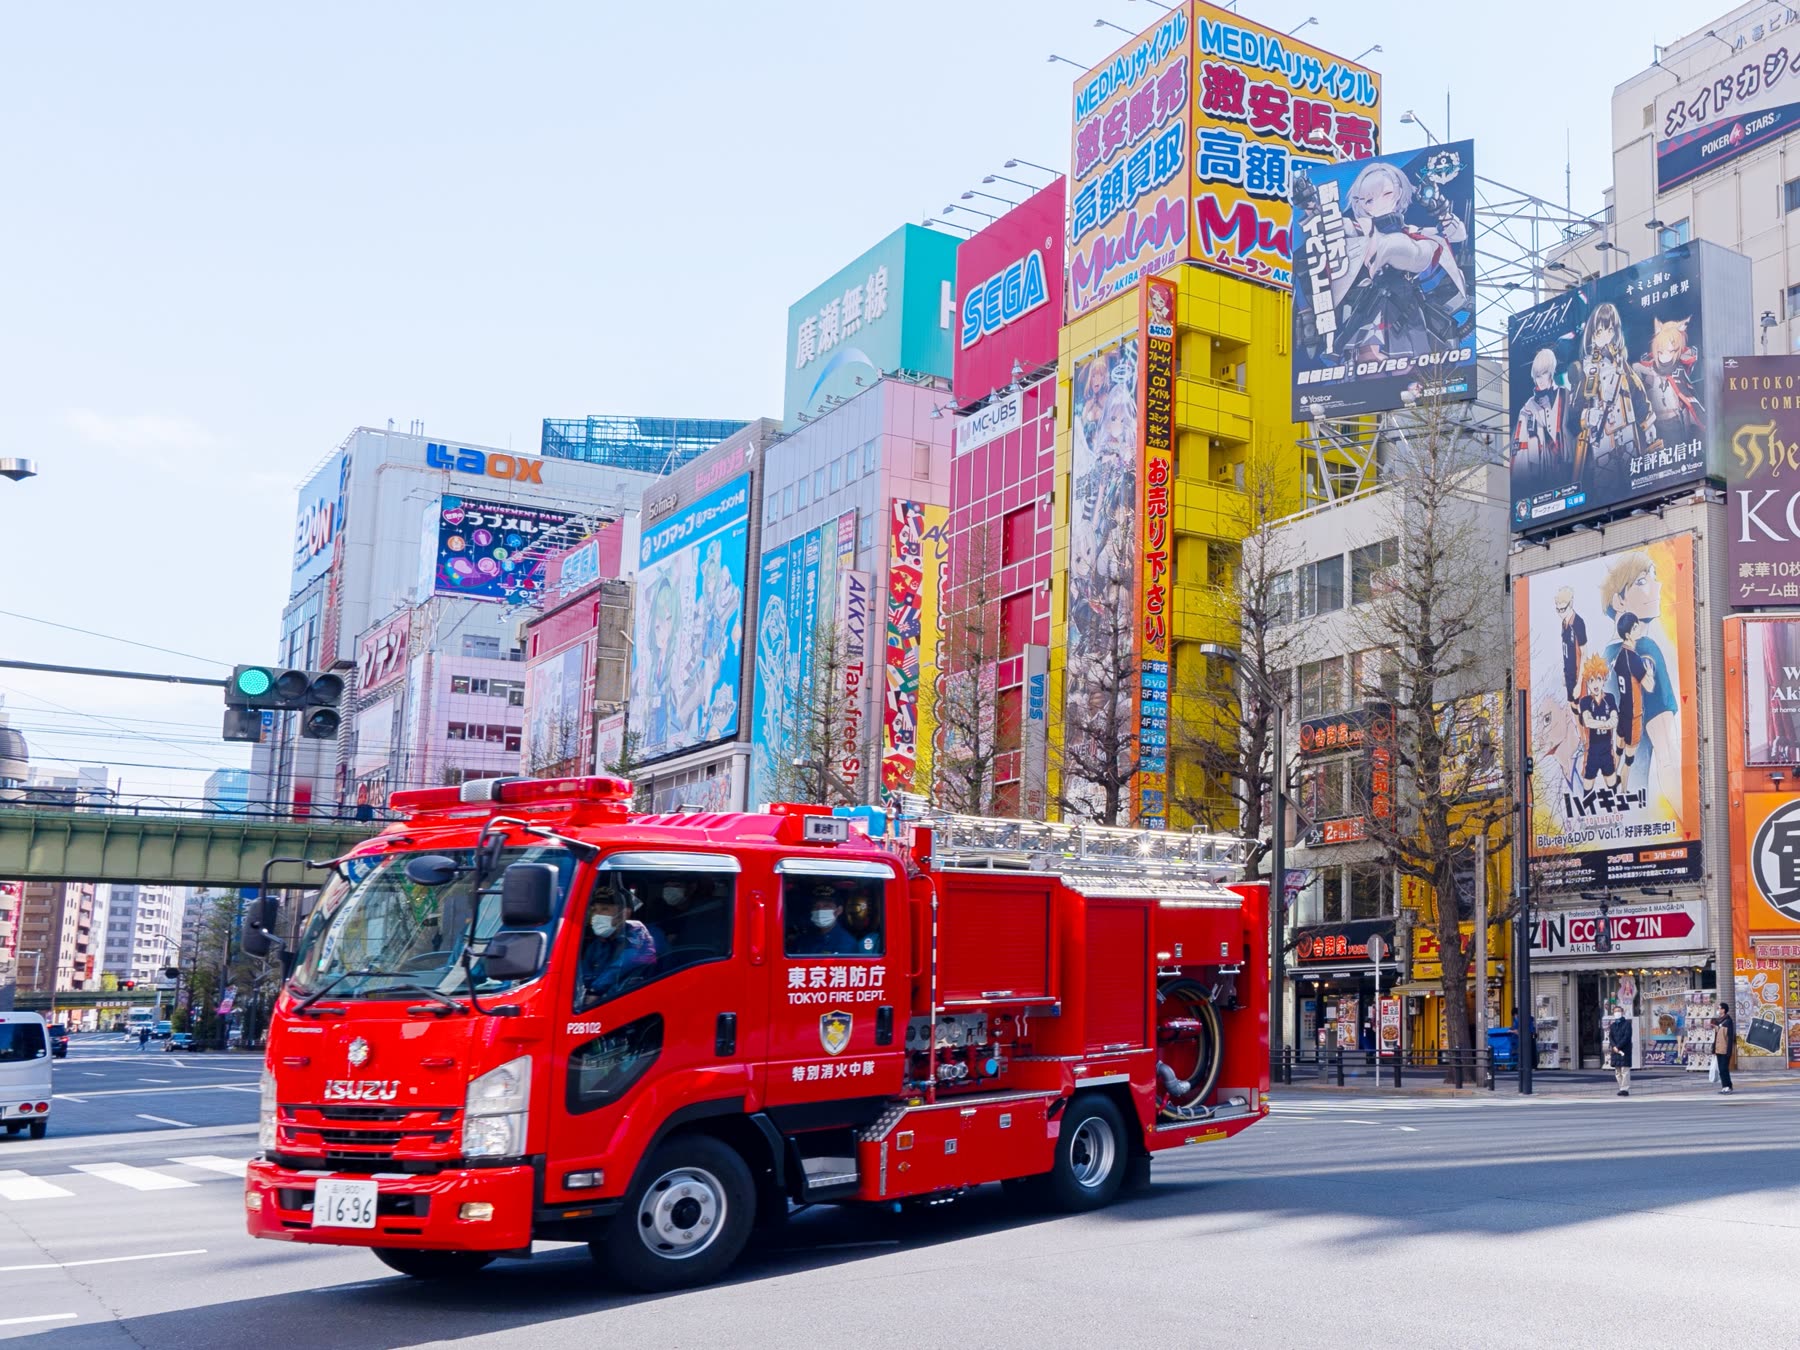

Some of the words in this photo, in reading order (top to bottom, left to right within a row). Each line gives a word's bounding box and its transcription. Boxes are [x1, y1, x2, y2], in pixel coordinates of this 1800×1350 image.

[1075, 9, 1187, 120] MEDIAリサイクル
[1199, 18, 1377, 106] MEDIAリサイクル
[1075, 58, 1187, 176] 激安販売
[1199, 62, 1374, 158] 激安販売
[1701, 133, 1730, 157] POKER
[1073, 121, 1184, 244] 高額買取
[1072, 195, 1185, 309] Mulan
[1216, 250, 1272, 277] ムーラン
[1272, 269, 1293, 283] AK
[962, 249, 1050, 350] SEGA
[1082, 283, 1114, 311] ムーラン
[1114, 269, 1139, 293] AKIBA
[1640, 278, 1690, 308] 明日の世界
[795, 264, 889, 370] 廣瀬無線
[1148, 325, 1173, 337] あなたの
[1148, 351, 1171, 363] ブルーレイ
[1149, 339, 1171, 353] DVD
[1148, 361, 1171, 377] ゲーム
[1152, 375, 1168, 388] CD
[1148, 387, 1170, 400] アイドル
[1147, 399, 1170, 412] アニメ
[1148, 411, 1169, 424] コミック
[1147, 435, 1169, 448] フィギュア
[1149, 425, 1169, 436] ホビー
[1628, 438, 1703, 477] 好評配信中
[478, 504, 538, 519] AMUSEMENT
[538, 512, 565, 522] PARK
[648, 493, 677, 520] Sofmap
[653, 512, 696, 552] ソフマップ
[1739, 583, 1800, 598] ゲーム曲
[1145, 678, 1166, 689] DVD
[1618, 675, 1626, 693] 9
[1783, 666, 1800, 681] W
[1029, 673, 1045, 721] SEGA
[1143, 705, 1166, 717] DVD
[1372, 745, 1391, 819] 吉野家
[1563, 788, 1647, 818] ハイキュー!!
[1537, 831, 1596, 848] Blu-ray&DVD
[1599, 827, 1620, 839] Vol.1
[1568, 910, 1597, 918] Professional
[1623, 906, 1648, 915] Magazine
[1571, 918, 1632, 942] COIC
[1635, 916, 1662, 938] ZIN
[1313, 934, 1347, 957] 吉野家
[787, 965, 886, 989] 東京消防庁
[787, 991, 827, 1005] TOKYO
[829, 990, 854, 1003] FIRE
[856, 989, 886, 1002] DEPT.
[566, 1022, 601, 1034] P28102
[791, 1060, 876, 1082] 特別消火中隊
[324, 1079, 400, 1101] ISUZU
